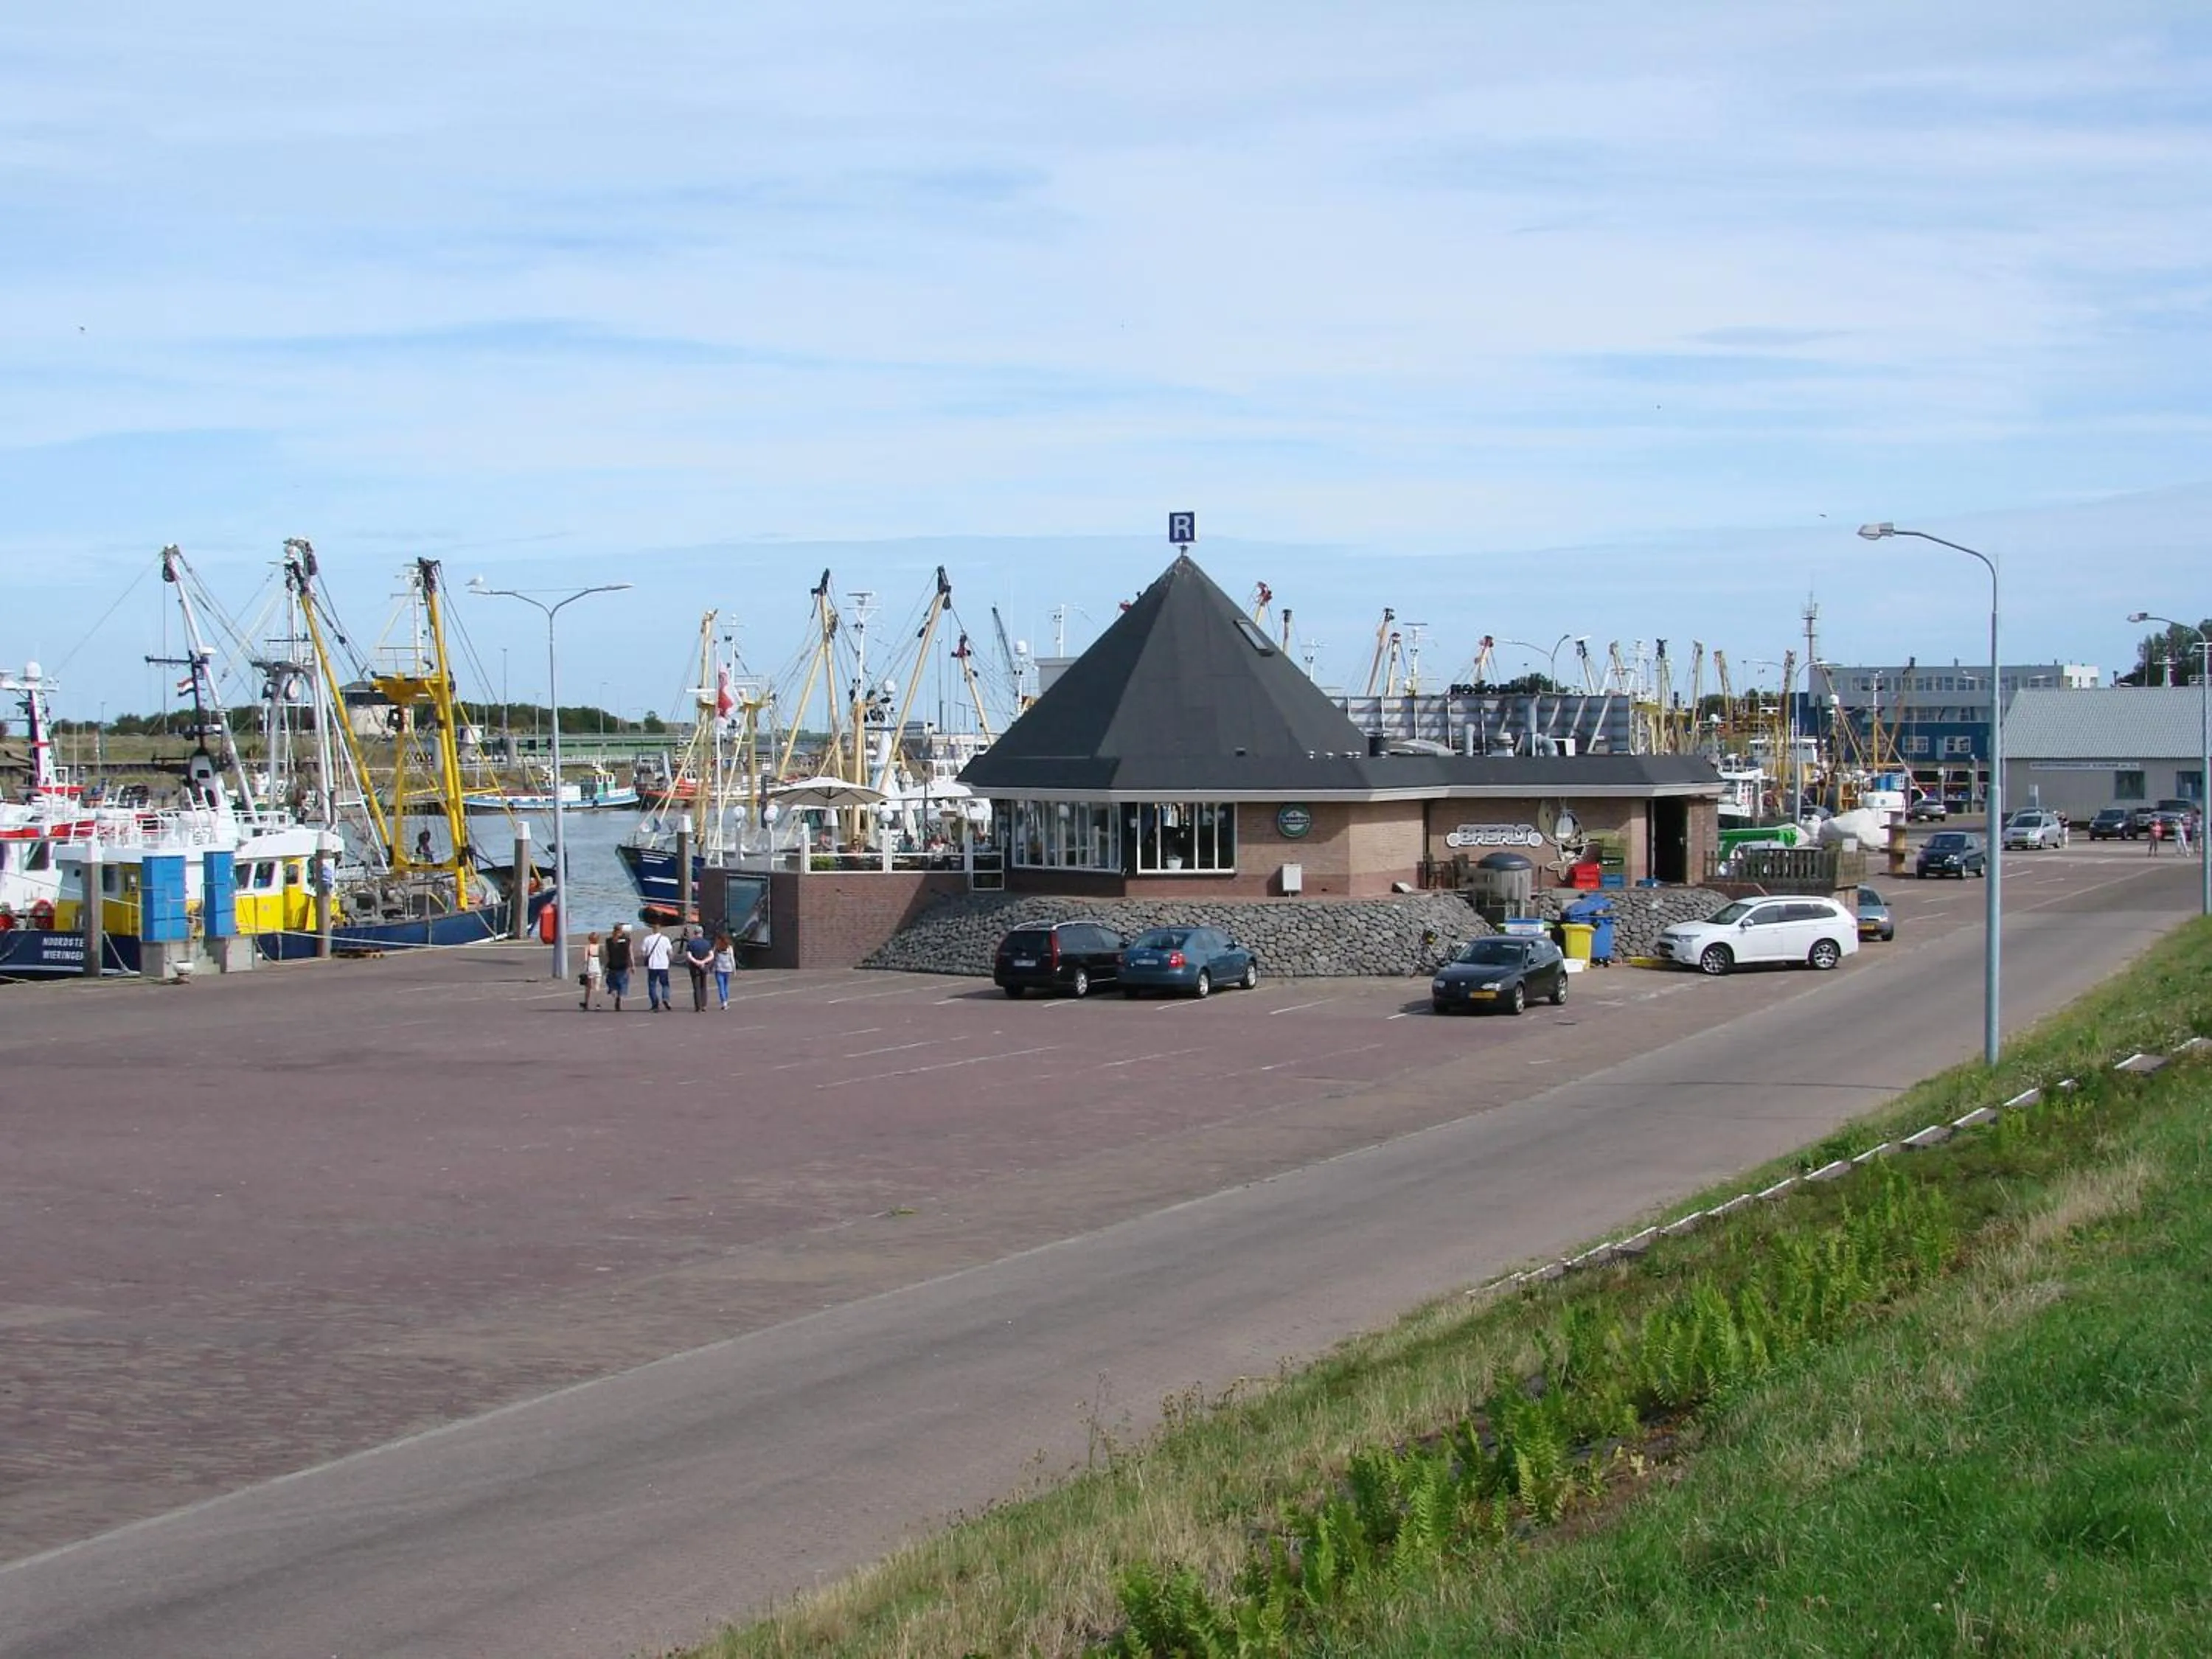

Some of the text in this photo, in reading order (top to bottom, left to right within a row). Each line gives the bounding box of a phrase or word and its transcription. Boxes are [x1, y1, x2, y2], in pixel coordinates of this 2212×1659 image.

[1174, 515, 1191, 539] R
[1458, 825, 1532, 843] BASALT
[43, 937, 83, 947] NOORDSTE
